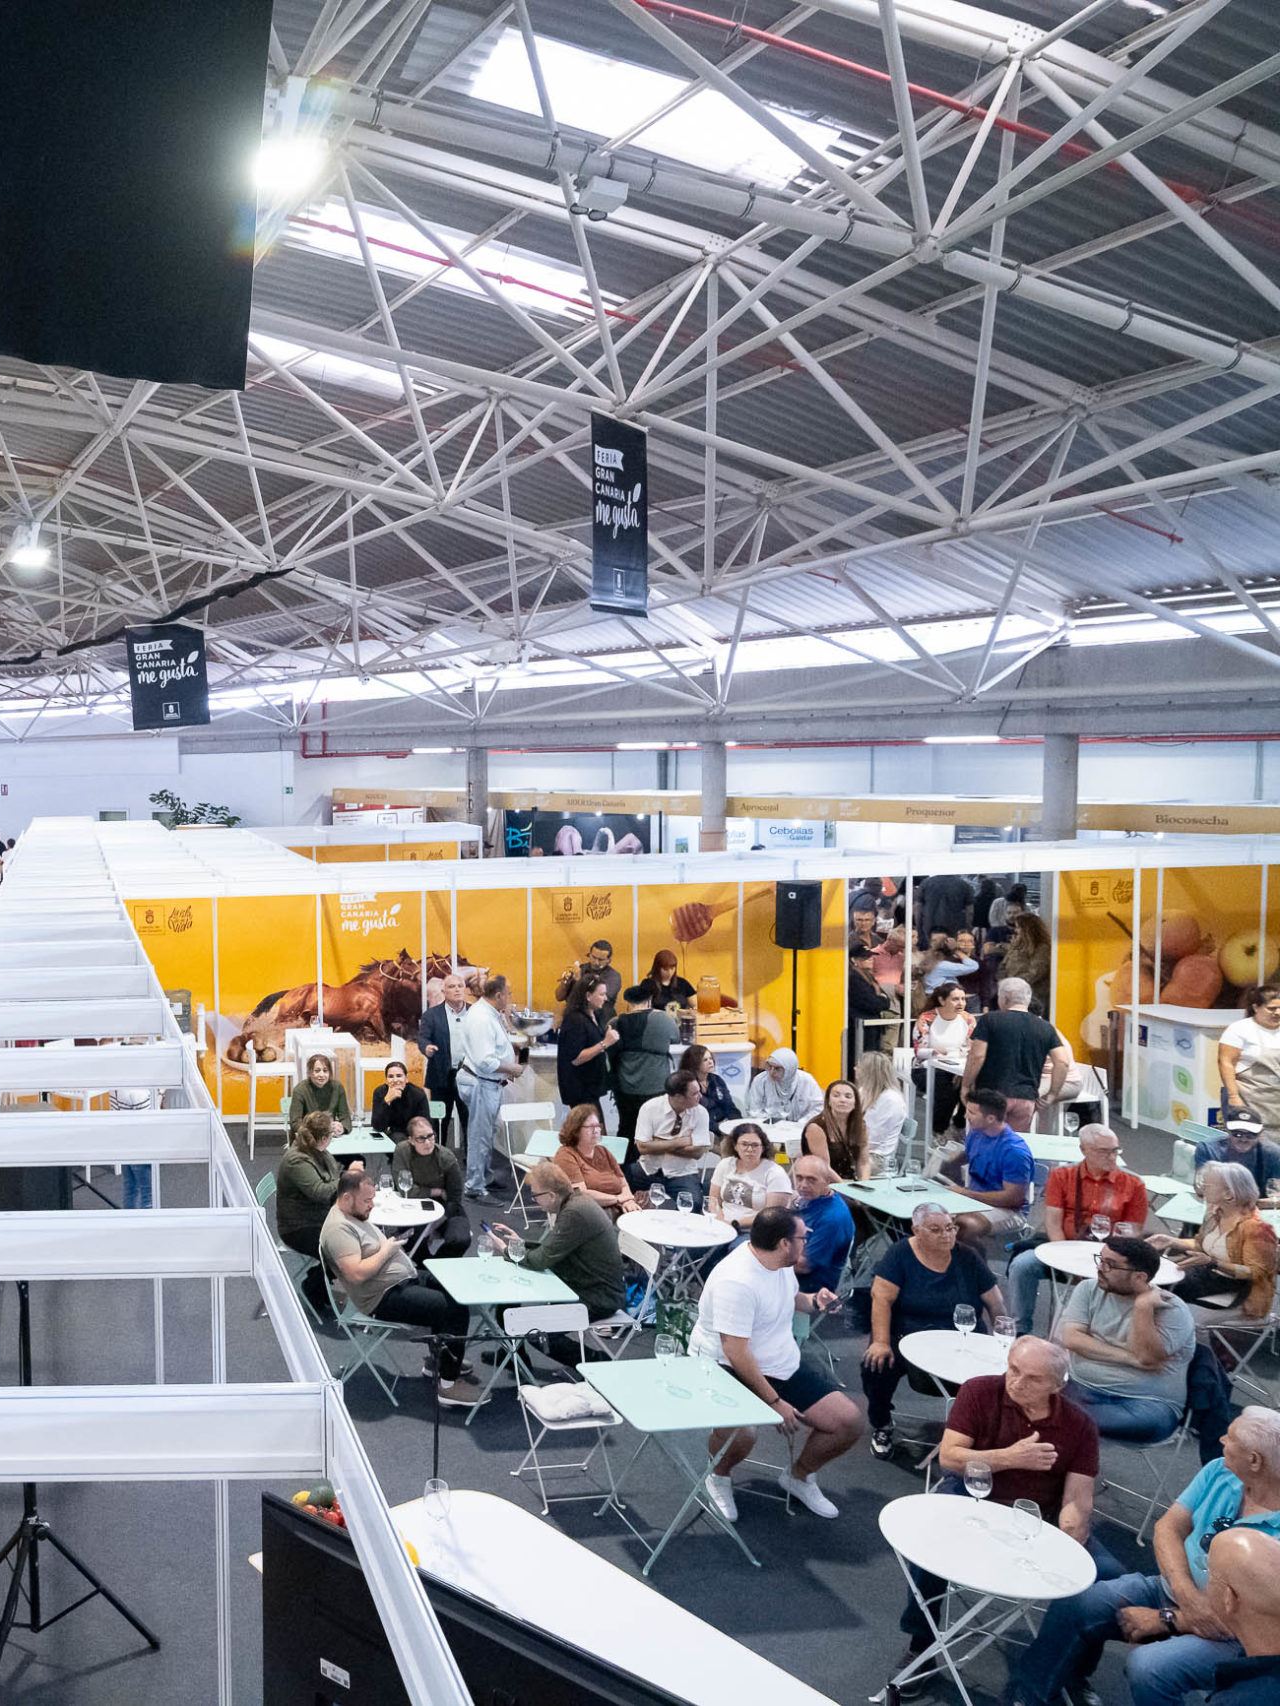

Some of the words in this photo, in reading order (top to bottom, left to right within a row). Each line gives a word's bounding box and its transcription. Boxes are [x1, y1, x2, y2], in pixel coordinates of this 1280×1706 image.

[596, 450, 618, 465] FERIA
[595, 466, 615, 482] GRAN
[595, 482, 625, 502] CANARIA
[595, 499, 612, 526] me
[612, 491, 640, 539] gusta
[136, 643, 164, 652] FERIA
[135, 652, 160, 661] GRAN
[136, 659, 176, 669] CANARIA
[137, 671, 157, 685] me
[159, 658, 198, 688] gusta
[1155, 814, 1229, 826] Biocosecha
[769, 826, 814, 835] Cebollas
[341, 919, 360, 932] me
[361, 909, 400, 936] gusta
